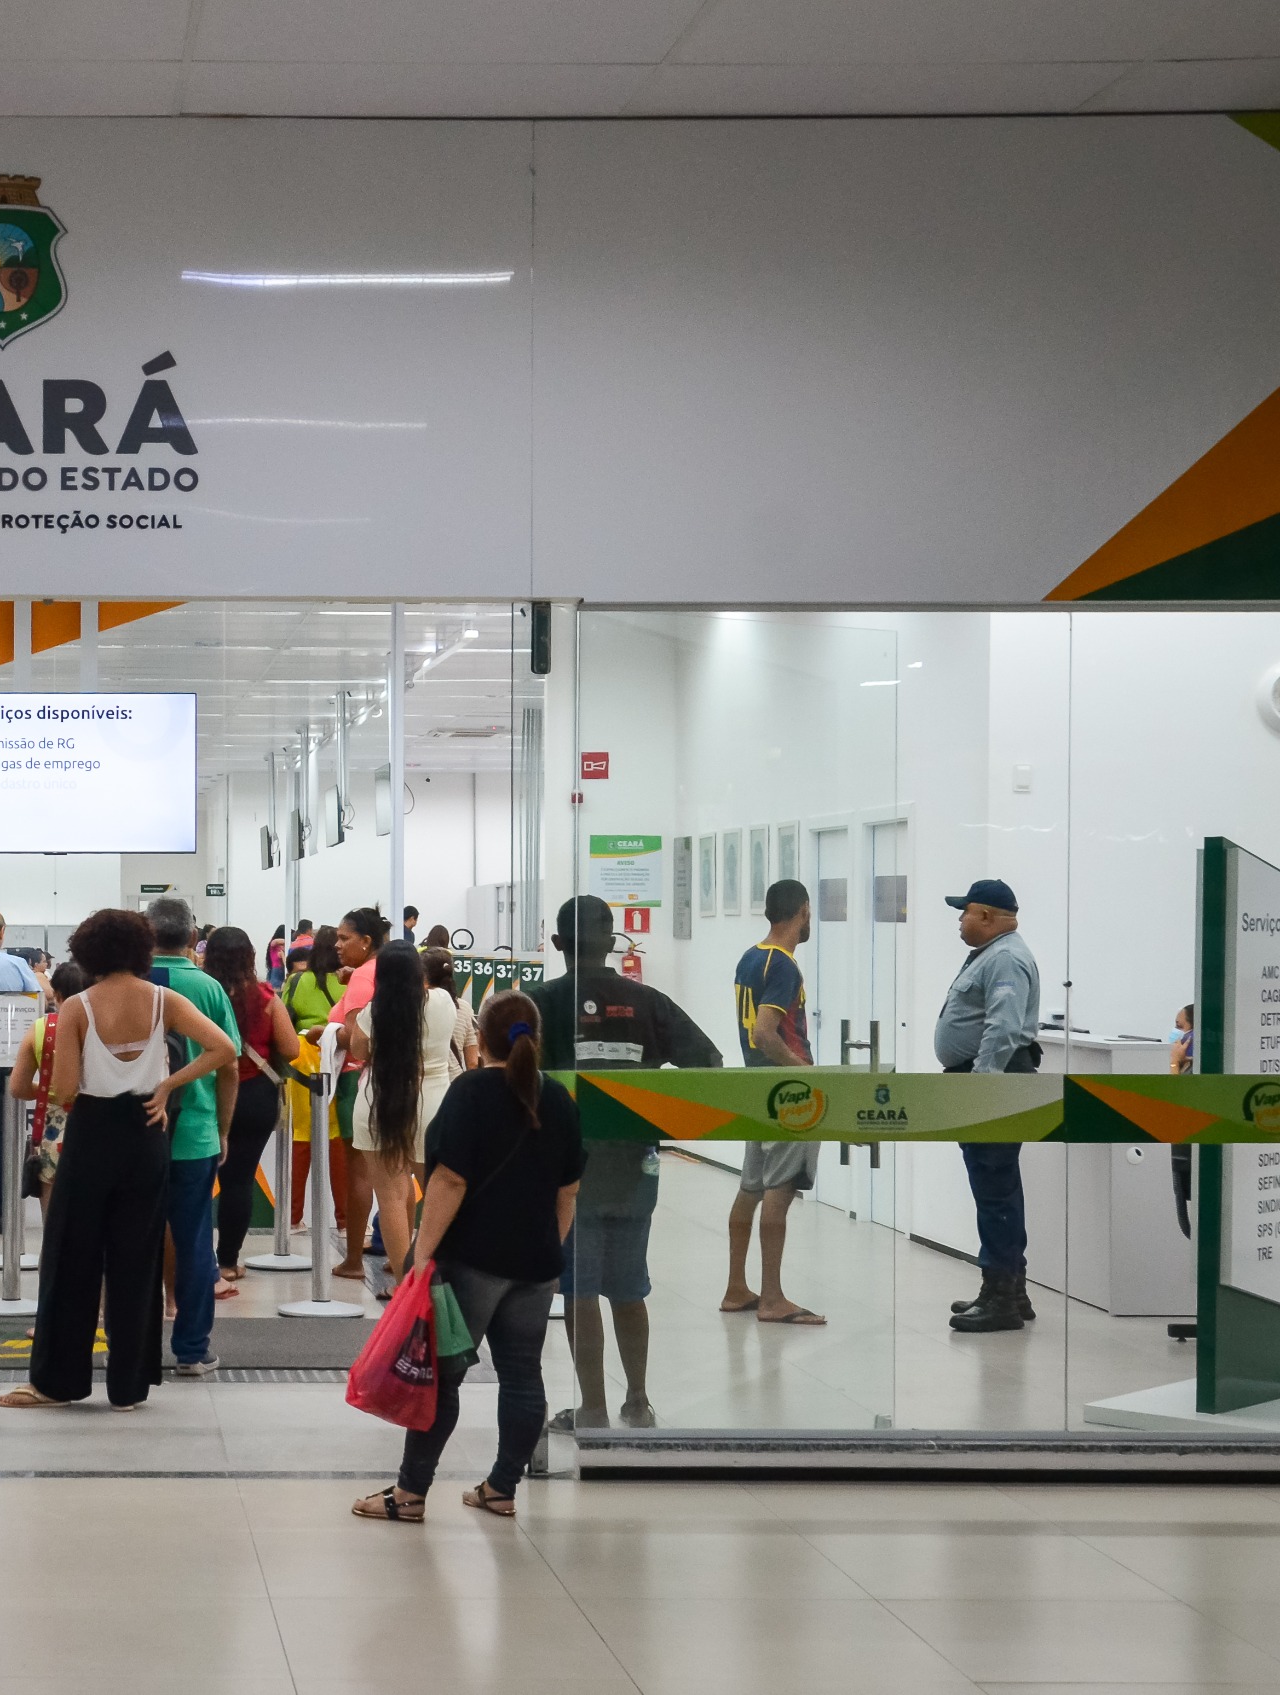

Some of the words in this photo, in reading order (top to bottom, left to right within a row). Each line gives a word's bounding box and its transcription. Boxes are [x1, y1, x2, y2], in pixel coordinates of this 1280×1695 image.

[60, 466, 199, 492] ESTADO
[106, 514, 183, 529] SOCIAL
[37, 705, 133, 722] disponíveis:
[38, 737, 54, 749] de
[57, 738, 75, 749] RG
[25, 757, 41, 769] de
[44, 760, 101, 771] emprego
[453, 960, 471, 973] 35
[473, 962, 493, 975] 36
[496, 964, 516, 978] 37
[1261, 966, 1280, 979] AMC
[521, 967, 543, 982] 37
[1261, 989, 1280, 1003] CAG
[778, 1087, 811, 1104] Vapt
[856, 1106, 908, 1120] CEARÁ
[1257, 1223, 1273, 1238] SPS
[1257, 1246, 1273, 1261] TRE
